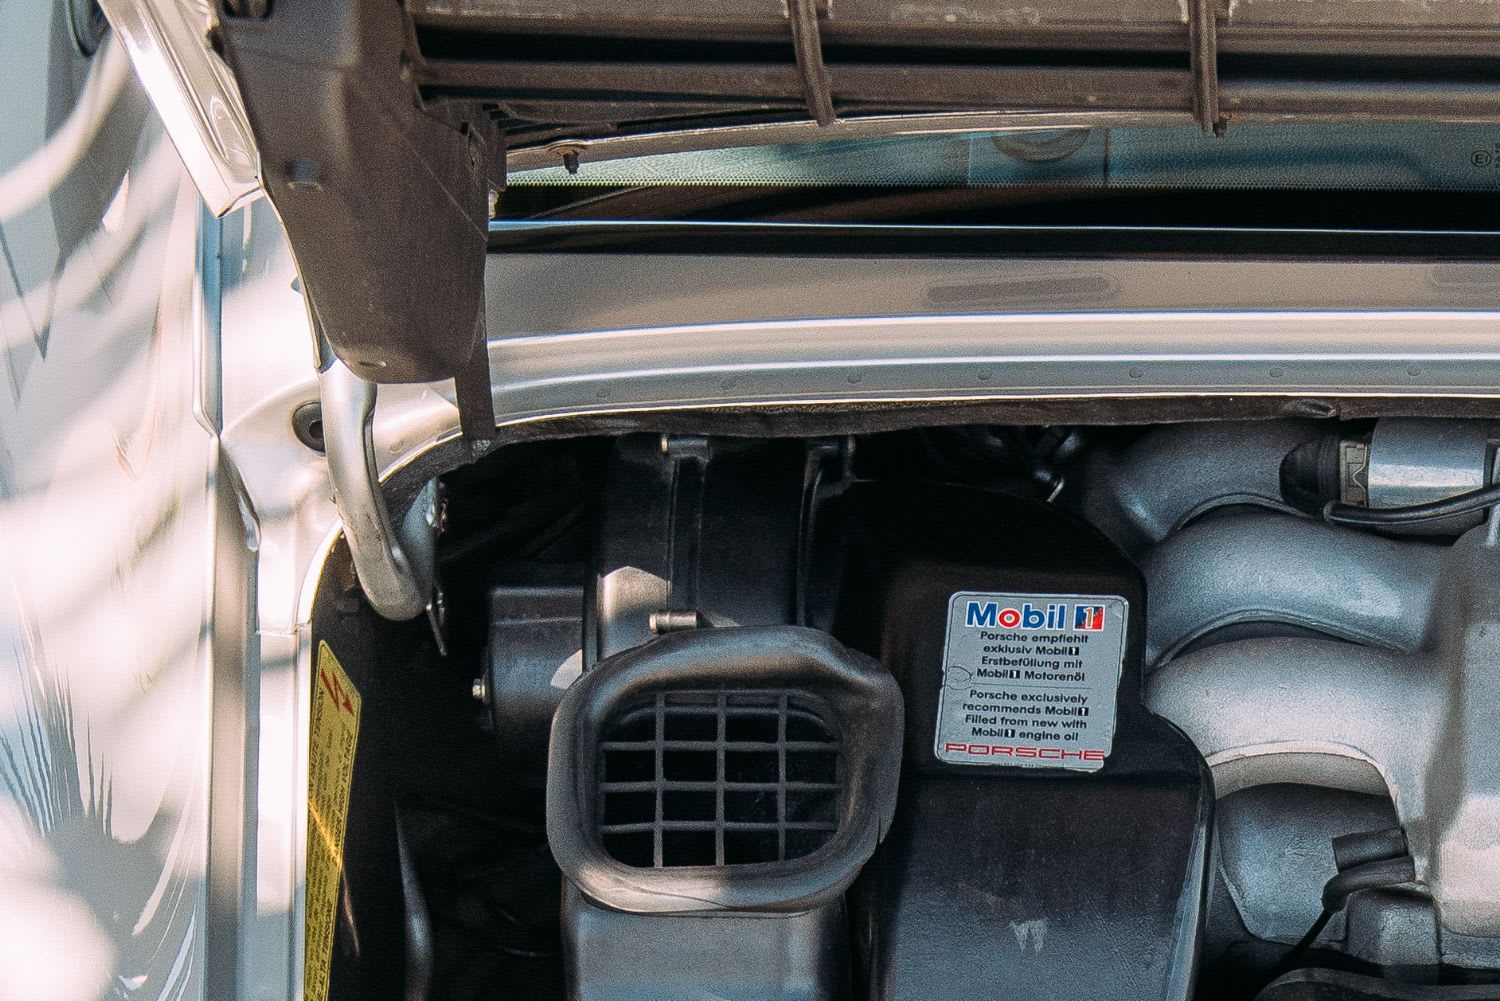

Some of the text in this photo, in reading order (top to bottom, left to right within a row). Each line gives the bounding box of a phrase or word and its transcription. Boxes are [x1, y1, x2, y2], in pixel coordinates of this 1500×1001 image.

[965, 601, 1066, 630] Mobil
[980, 631, 1089, 644] Porsche empfiehlt
[983, 645, 1032, 654] exklusiv
[981, 657, 1083, 669] Erstbefüllung mit
[1024, 671, 1085, 681] Motorenöl
[970, 690, 1088, 704] Porsche exclusively
[962, 703, 1041, 714] recommends
[965, 715, 1087, 728] Filled from new with
[1019, 731, 1060, 741] engine
[1064, 732, 1078, 741] oil
[945, 742, 1105, 760] PORSCHE
